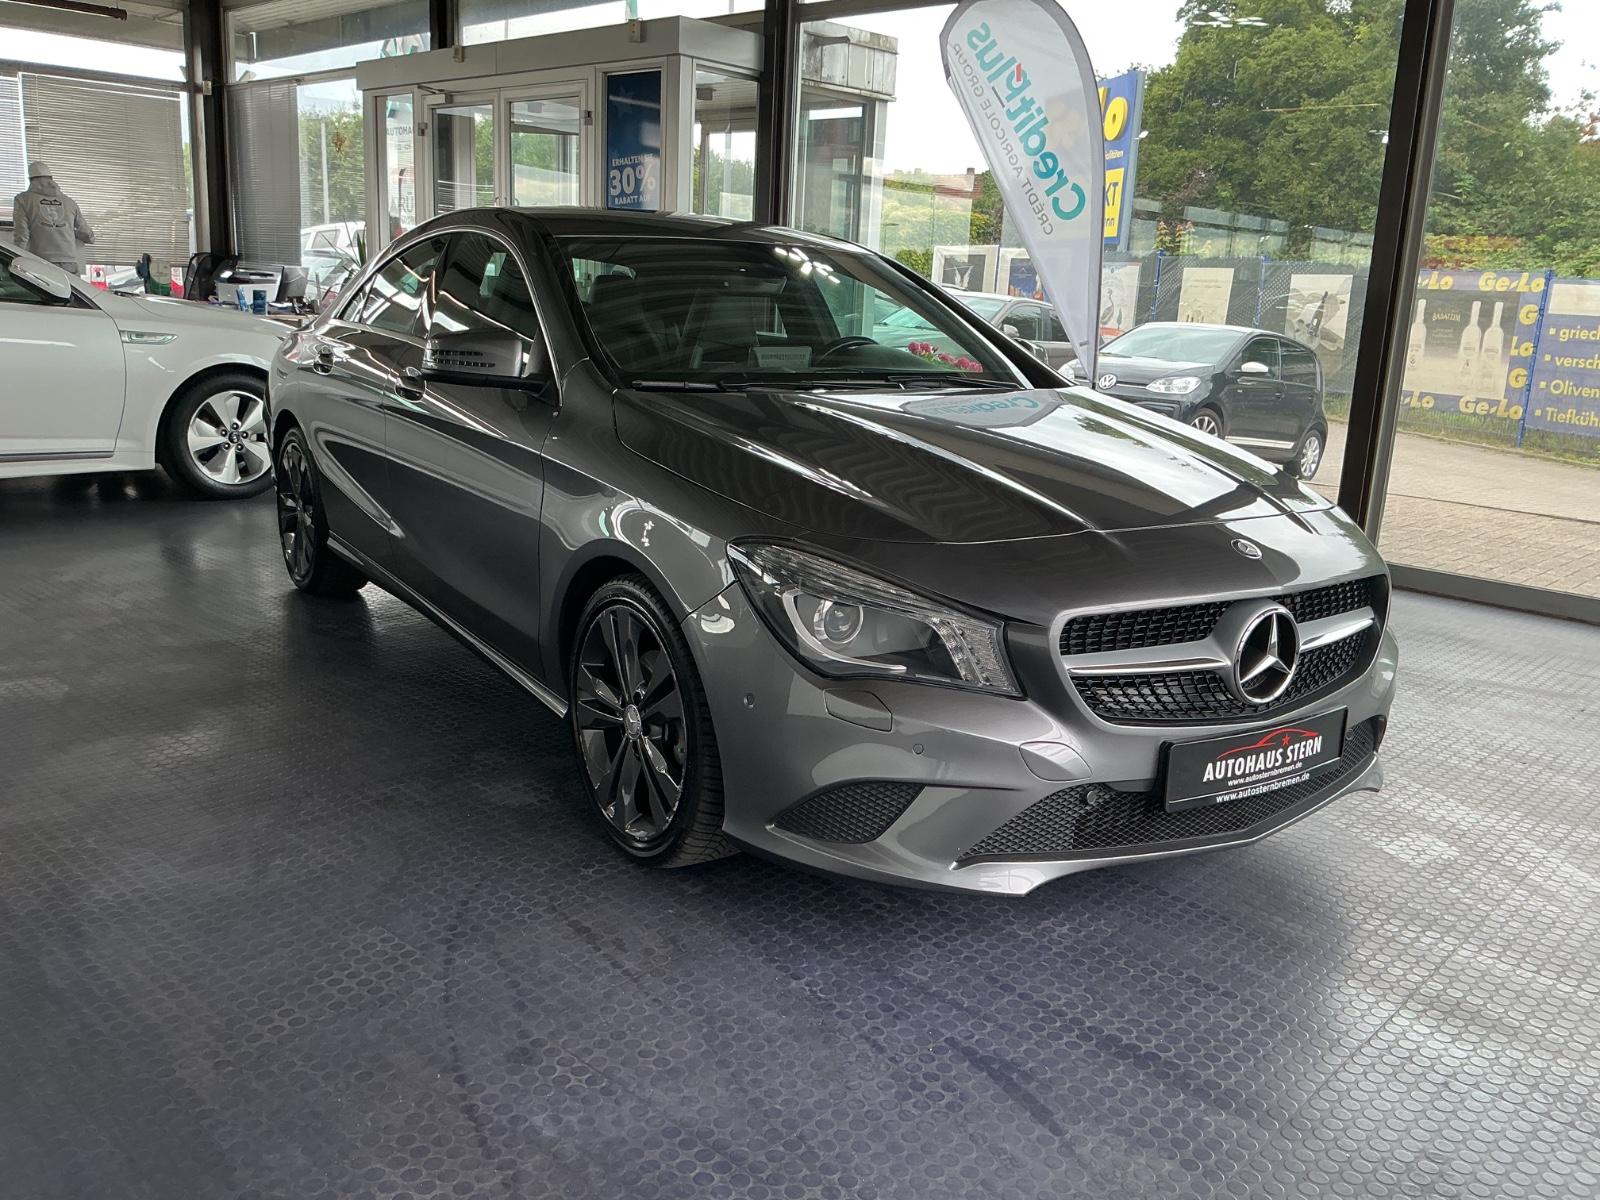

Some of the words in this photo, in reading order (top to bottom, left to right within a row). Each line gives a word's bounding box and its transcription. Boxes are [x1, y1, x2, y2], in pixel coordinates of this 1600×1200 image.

[609, 164, 656, 196] 30%
[614, 195, 638, 205] RABATT
[1203, 748, 1284, 782] AUTOHAUS
[1286, 735, 1322, 764] STERN
[1216, 772, 1310, 803] www.autosternbremen.de
[1227, 762, 1303, 787] www.autosternbremen.de
